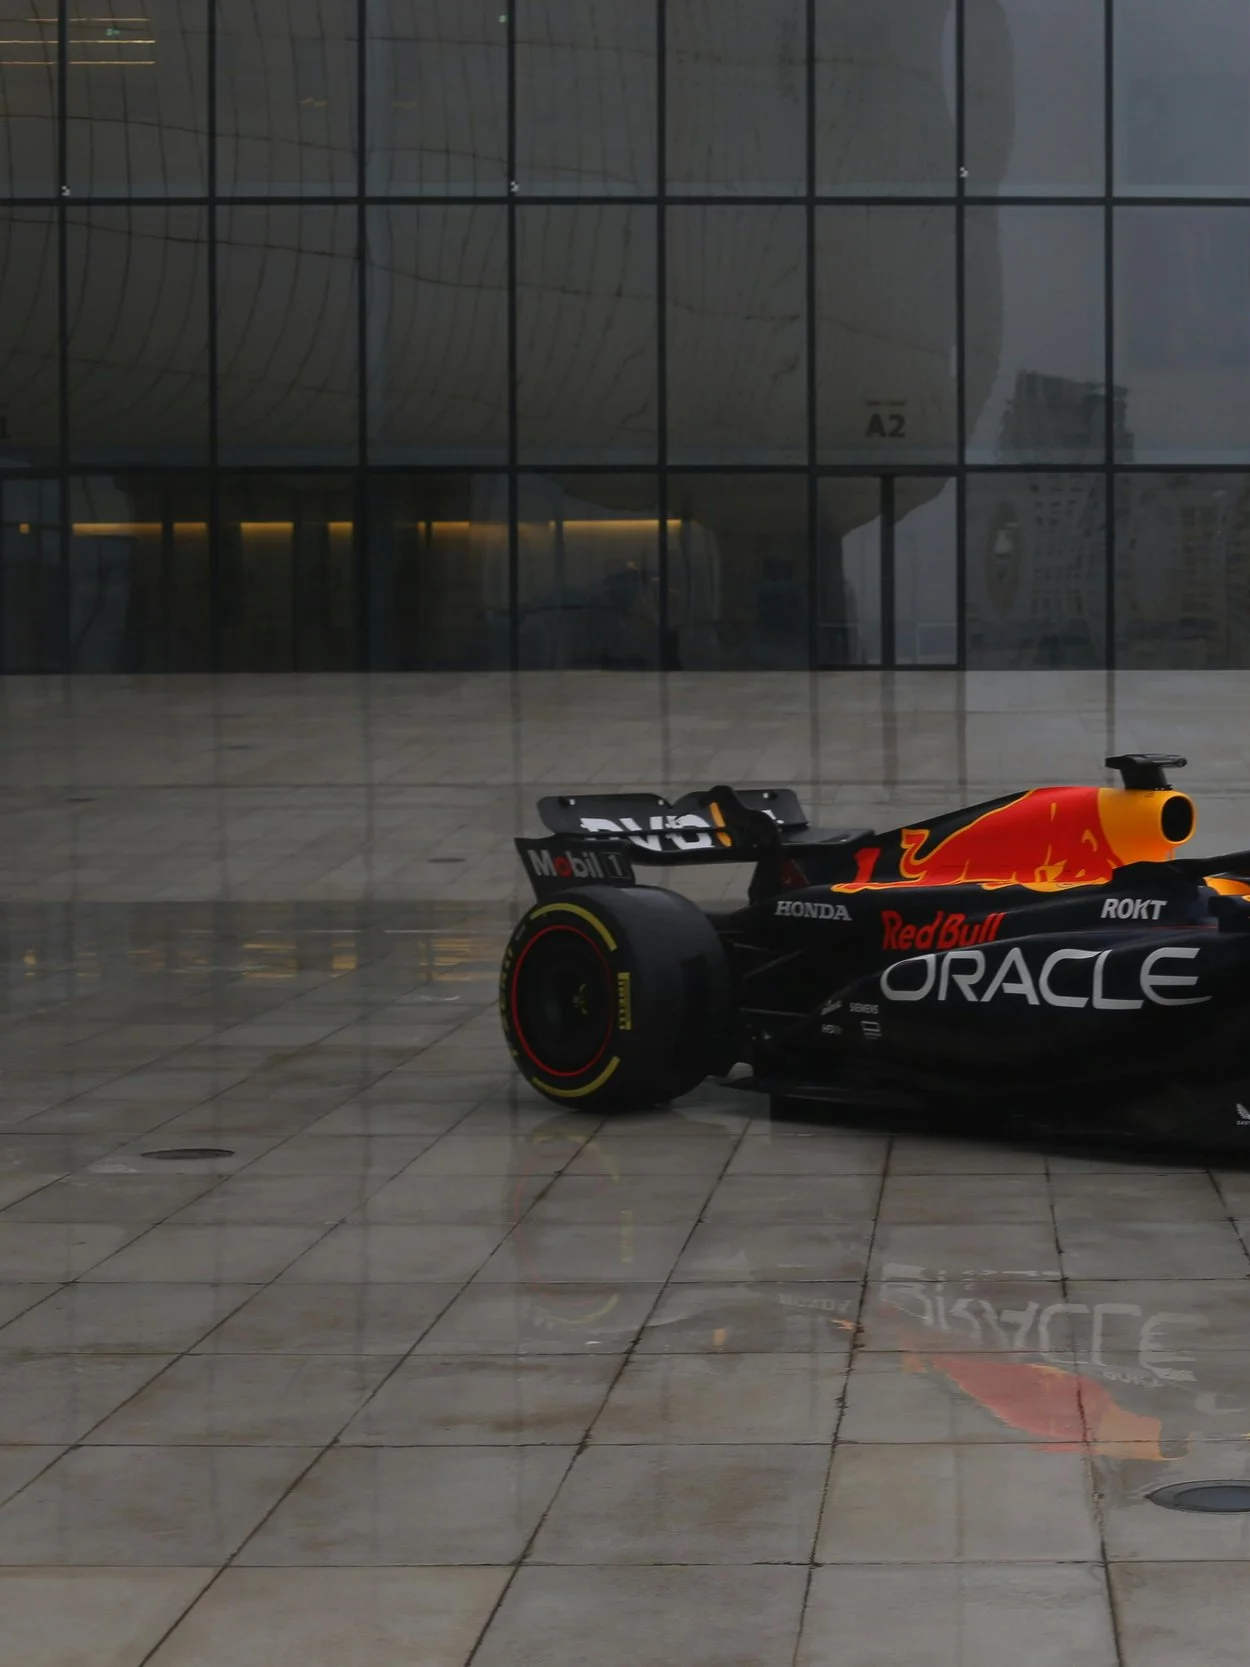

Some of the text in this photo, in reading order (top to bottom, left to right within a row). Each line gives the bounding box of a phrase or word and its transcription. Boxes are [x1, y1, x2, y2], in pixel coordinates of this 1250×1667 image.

[865, 413, 906, 438] A2
[528, 849, 604, 878] Mobil
[774, 901, 853, 921] HONDA
[1100, 898, 1167, 920] ROKT
[880, 947, 1212, 1010] ORACLE
